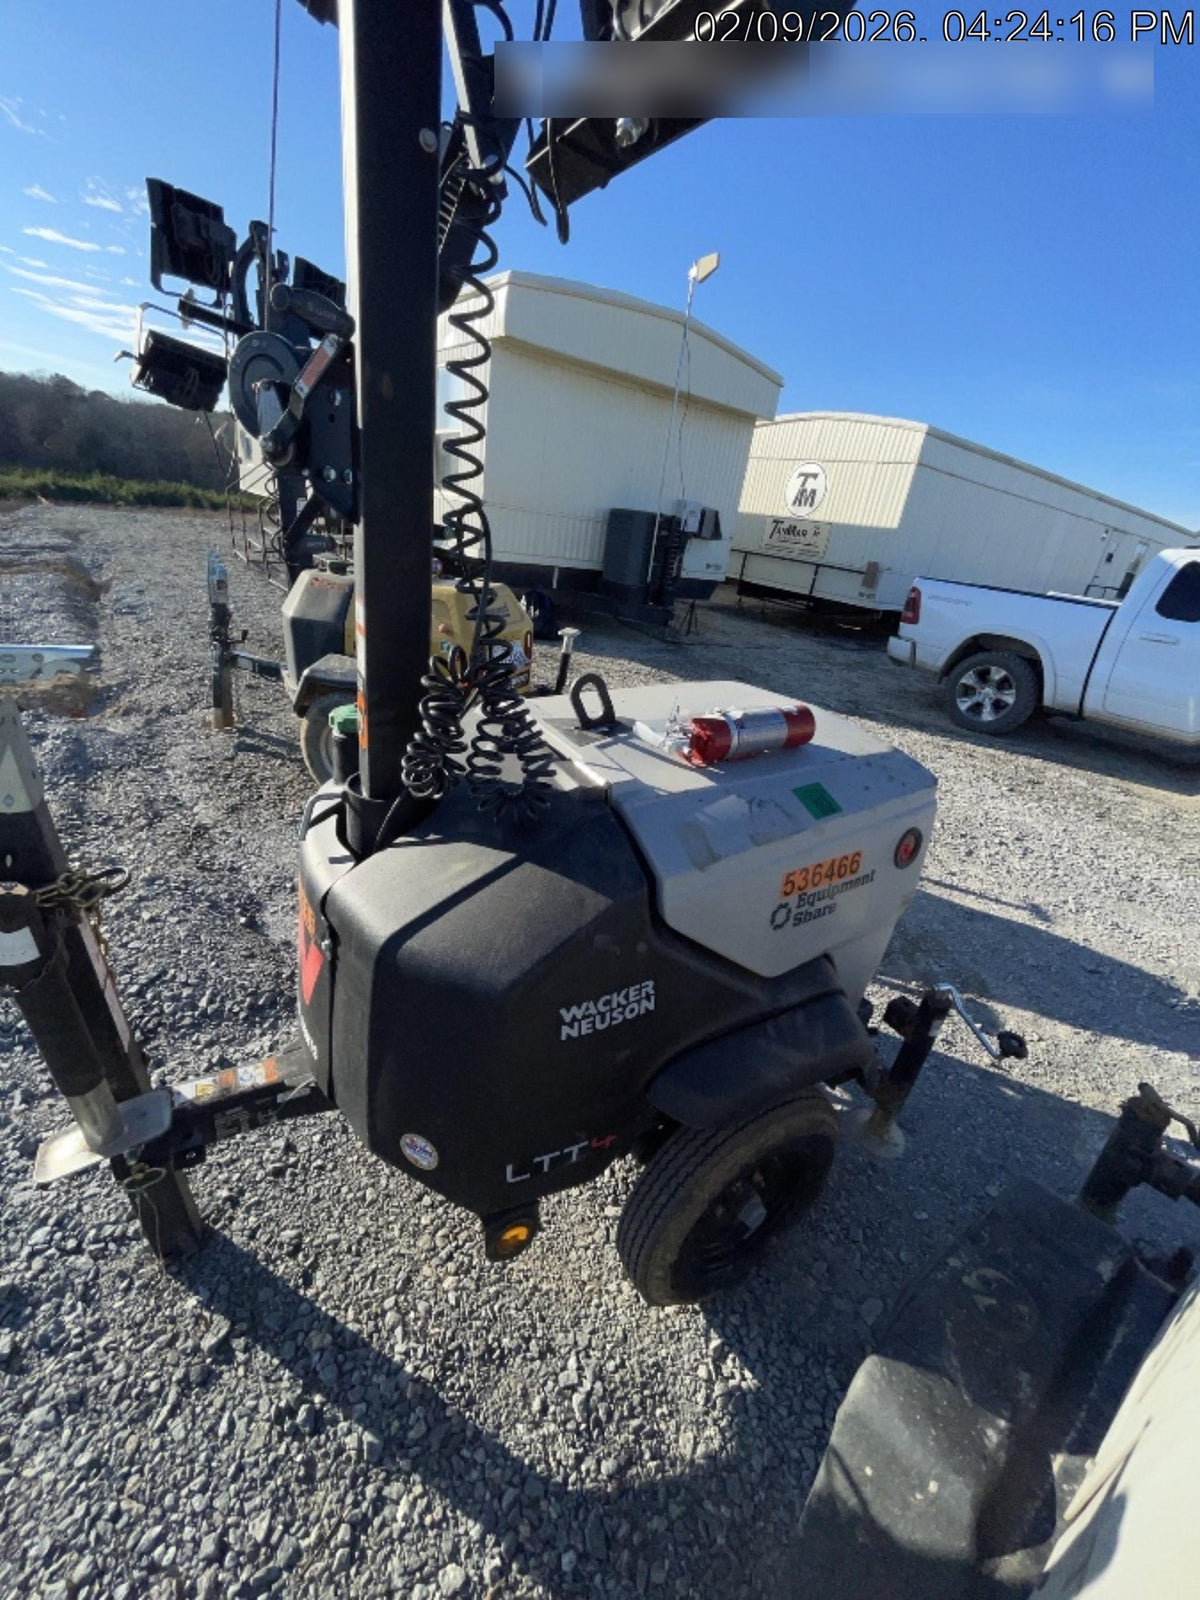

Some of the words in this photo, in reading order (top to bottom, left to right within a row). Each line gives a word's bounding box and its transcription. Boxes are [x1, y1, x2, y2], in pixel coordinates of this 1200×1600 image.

[783, 851, 862, 897] 536466
[796, 868, 876, 908] Equipment
[792, 902, 837, 928] Share
[559, 980, 655, 1023] WACKER
[560, 995, 655, 1041] NEUSON
